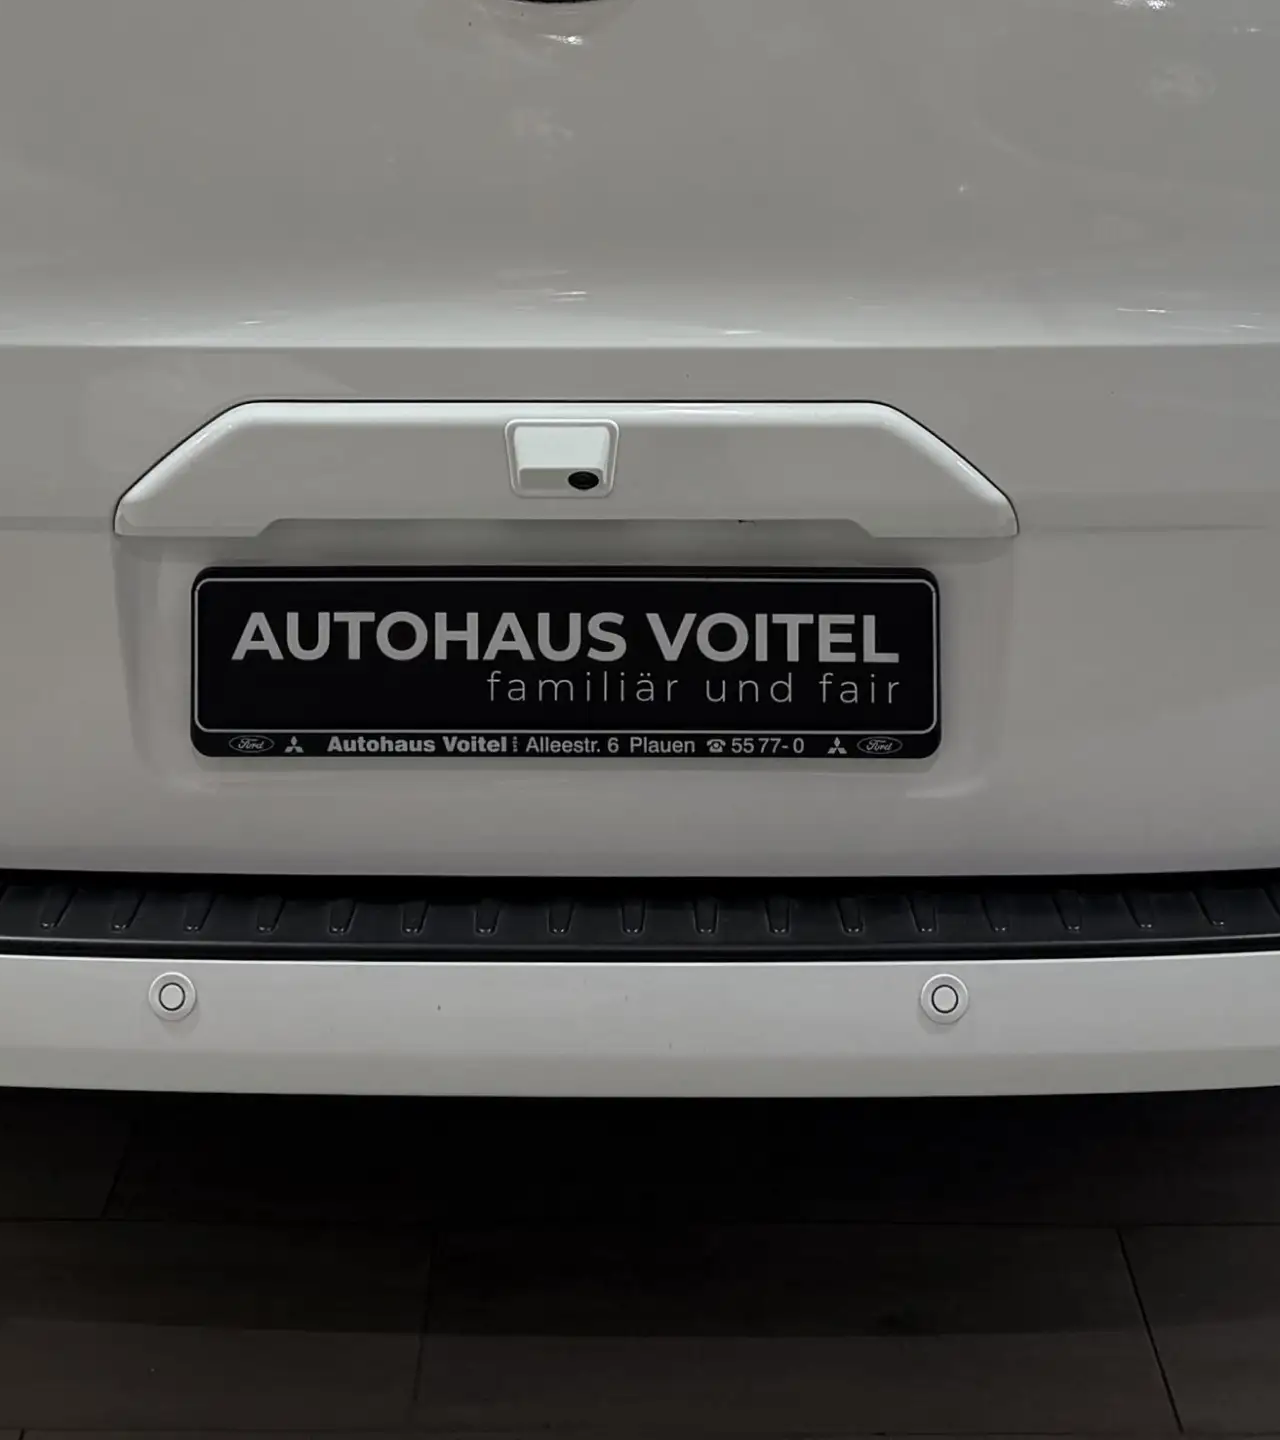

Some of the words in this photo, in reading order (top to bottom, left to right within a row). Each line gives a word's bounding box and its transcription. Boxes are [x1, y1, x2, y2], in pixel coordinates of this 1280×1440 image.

[231, 611, 628, 662] AUTOHAUS
[645, 612, 901, 664] VOITEL
[486, 670, 679, 703] familiär
[705, 672, 793, 703] und
[818, 672, 901, 704] fair
[326, 736, 436, 753] Autohaus
[442, 736, 508, 753] Voitel
[525, 736, 601, 753] Alleestr.
[607, 737, 619, 753] 6
[629, 737, 696, 753] Plauen
